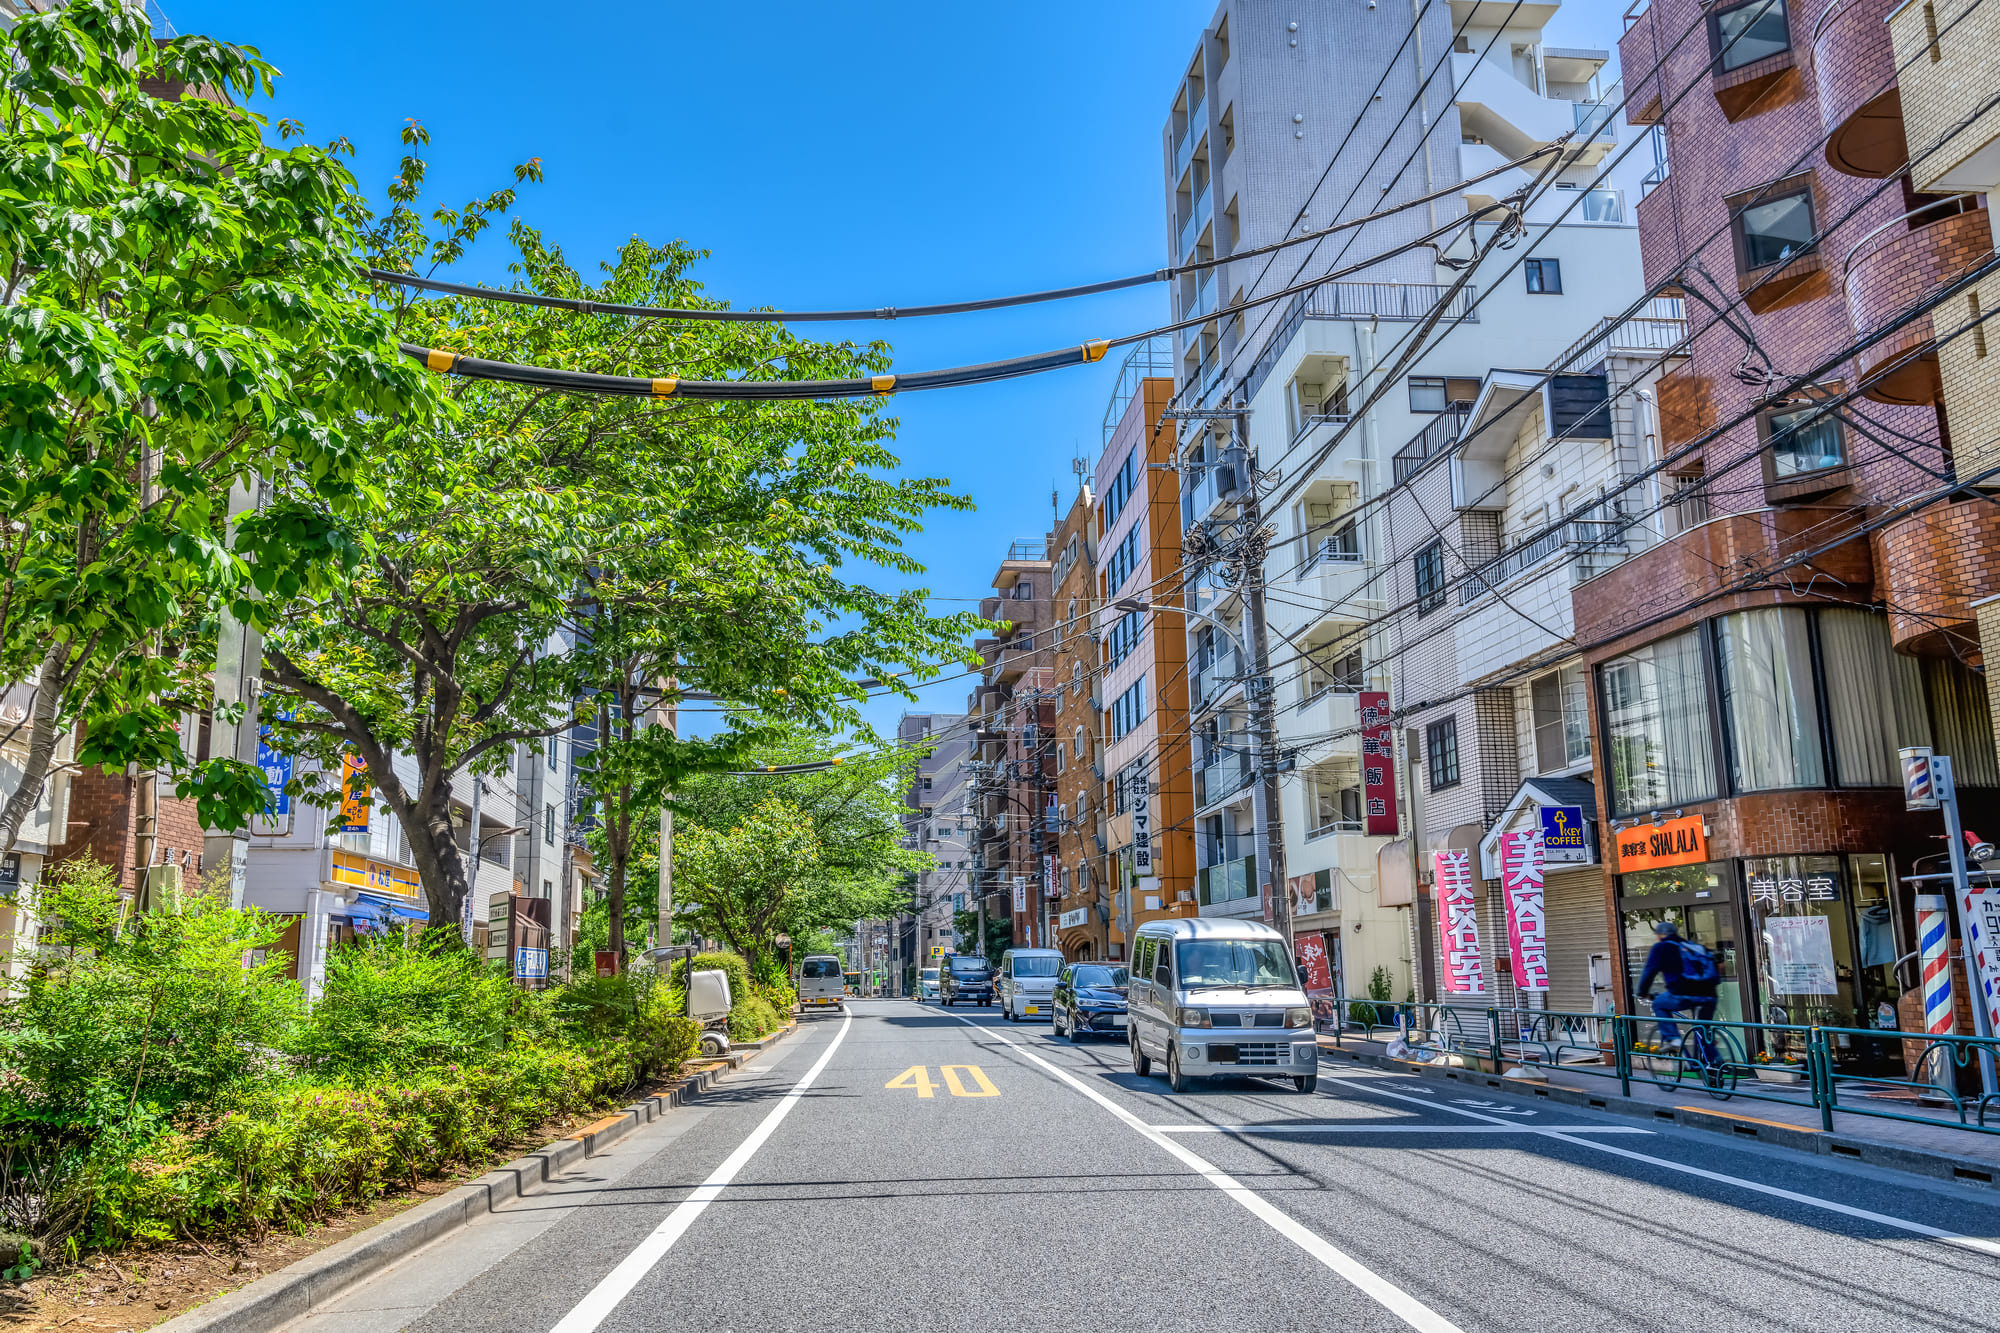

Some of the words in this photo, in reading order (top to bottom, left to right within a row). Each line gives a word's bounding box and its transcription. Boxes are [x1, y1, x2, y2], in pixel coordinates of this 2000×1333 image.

[1134, 799, 1149, 867] シマ建設
[1545, 836, 1582, 845] COFFEE
[1563, 827, 1581, 836] KEY
[1621, 841, 1647, 857] 美容室
[1650, 827, 1699, 857] SHALALA
[1751, 876, 1835, 902] 美容室
[1441, 850, 1486, 995] 美容室
[1504, 830, 1550, 991] 美容室
[884, 1065, 1001, 1098] 40
